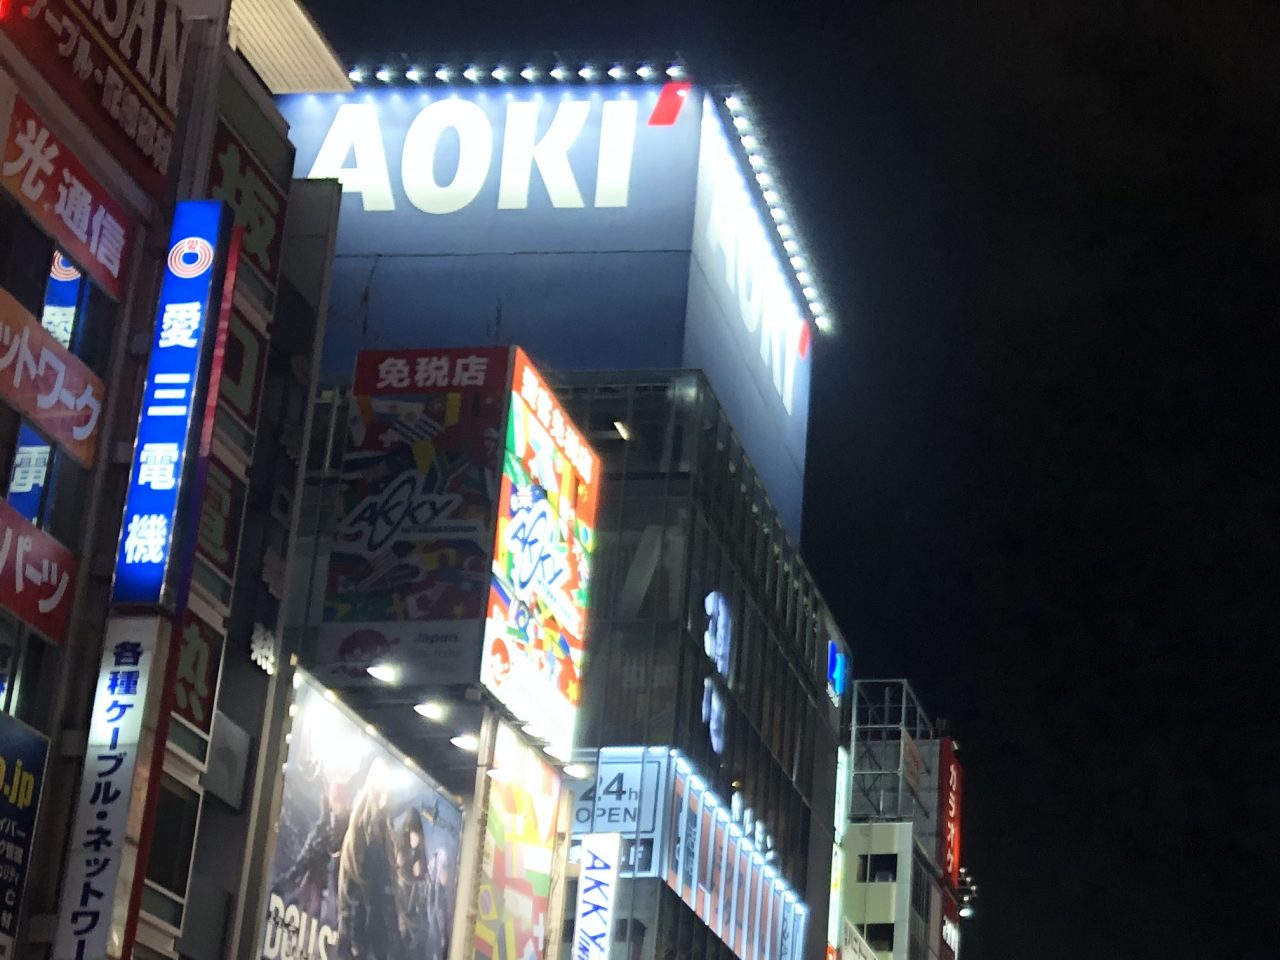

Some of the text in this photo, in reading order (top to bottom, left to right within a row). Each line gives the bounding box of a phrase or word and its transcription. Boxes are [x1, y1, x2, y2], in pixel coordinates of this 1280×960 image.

[3, 119, 126, 278] 光通信
[307, 99, 638, 214] AOKI
[376, 357, 490, 389] 免税店
[124, 303, 201, 563] 愛三電機
[575, 807, 639, 824] OPEN
[579, 772, 638, 801] 24h
[581, 849, 612, 953] AKKY
